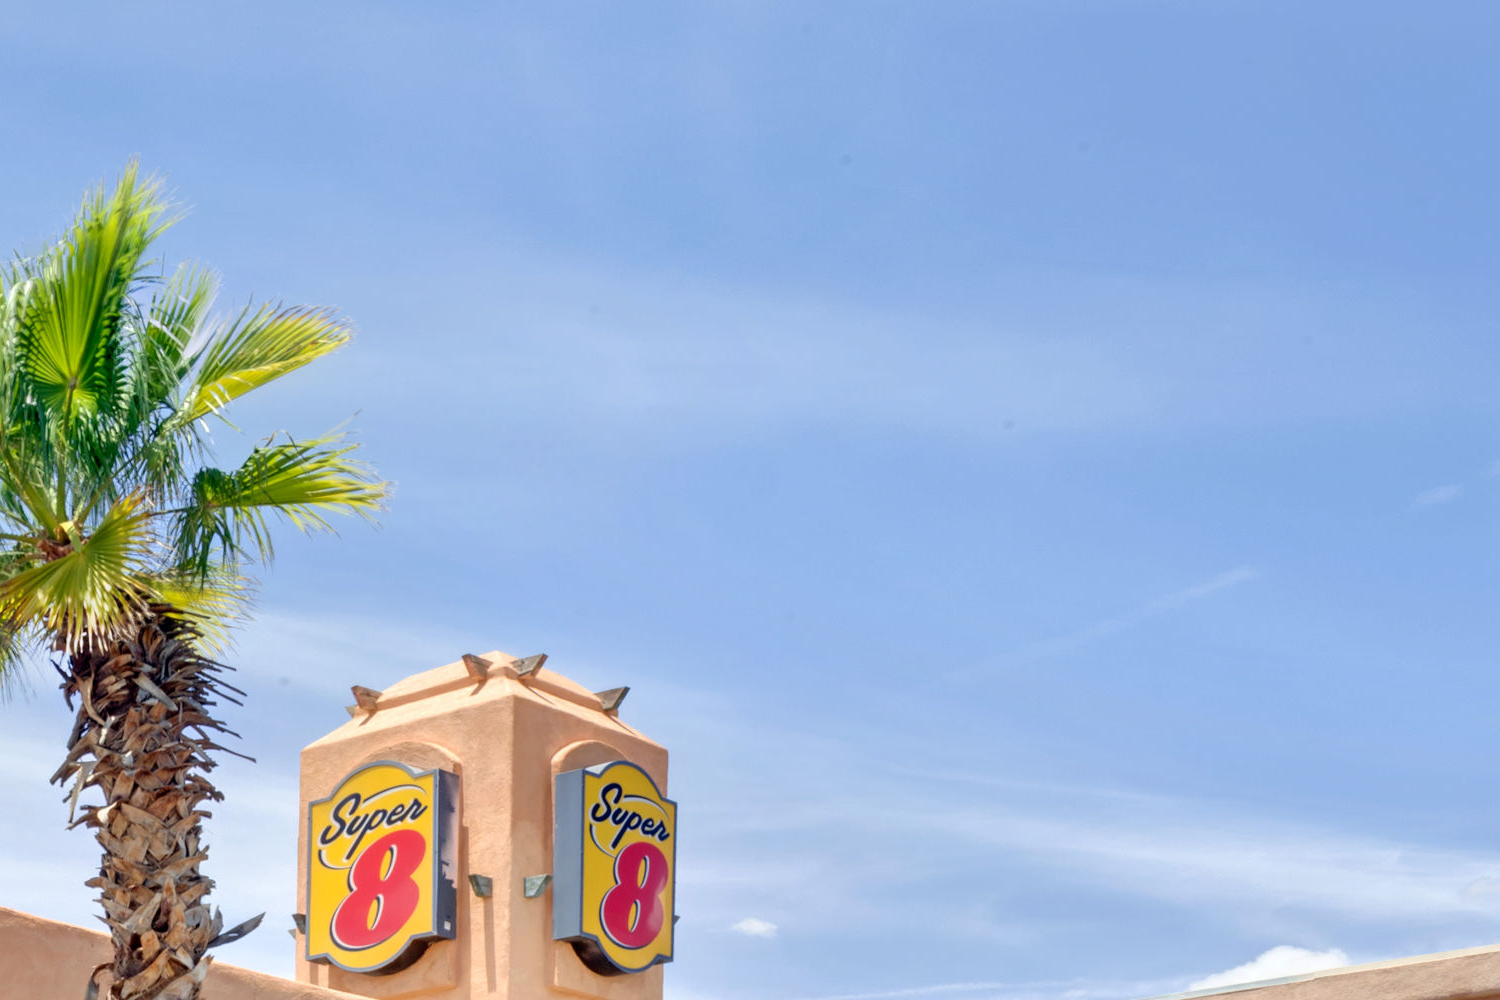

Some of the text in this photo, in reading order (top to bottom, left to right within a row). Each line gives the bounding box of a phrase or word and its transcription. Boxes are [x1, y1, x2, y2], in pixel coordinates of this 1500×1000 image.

[318, 792, 428, 862] Super
[589, 782, 670, 850] Super
[330, 829, 426, 951] 8
[599, 841, 669, 950] 8
